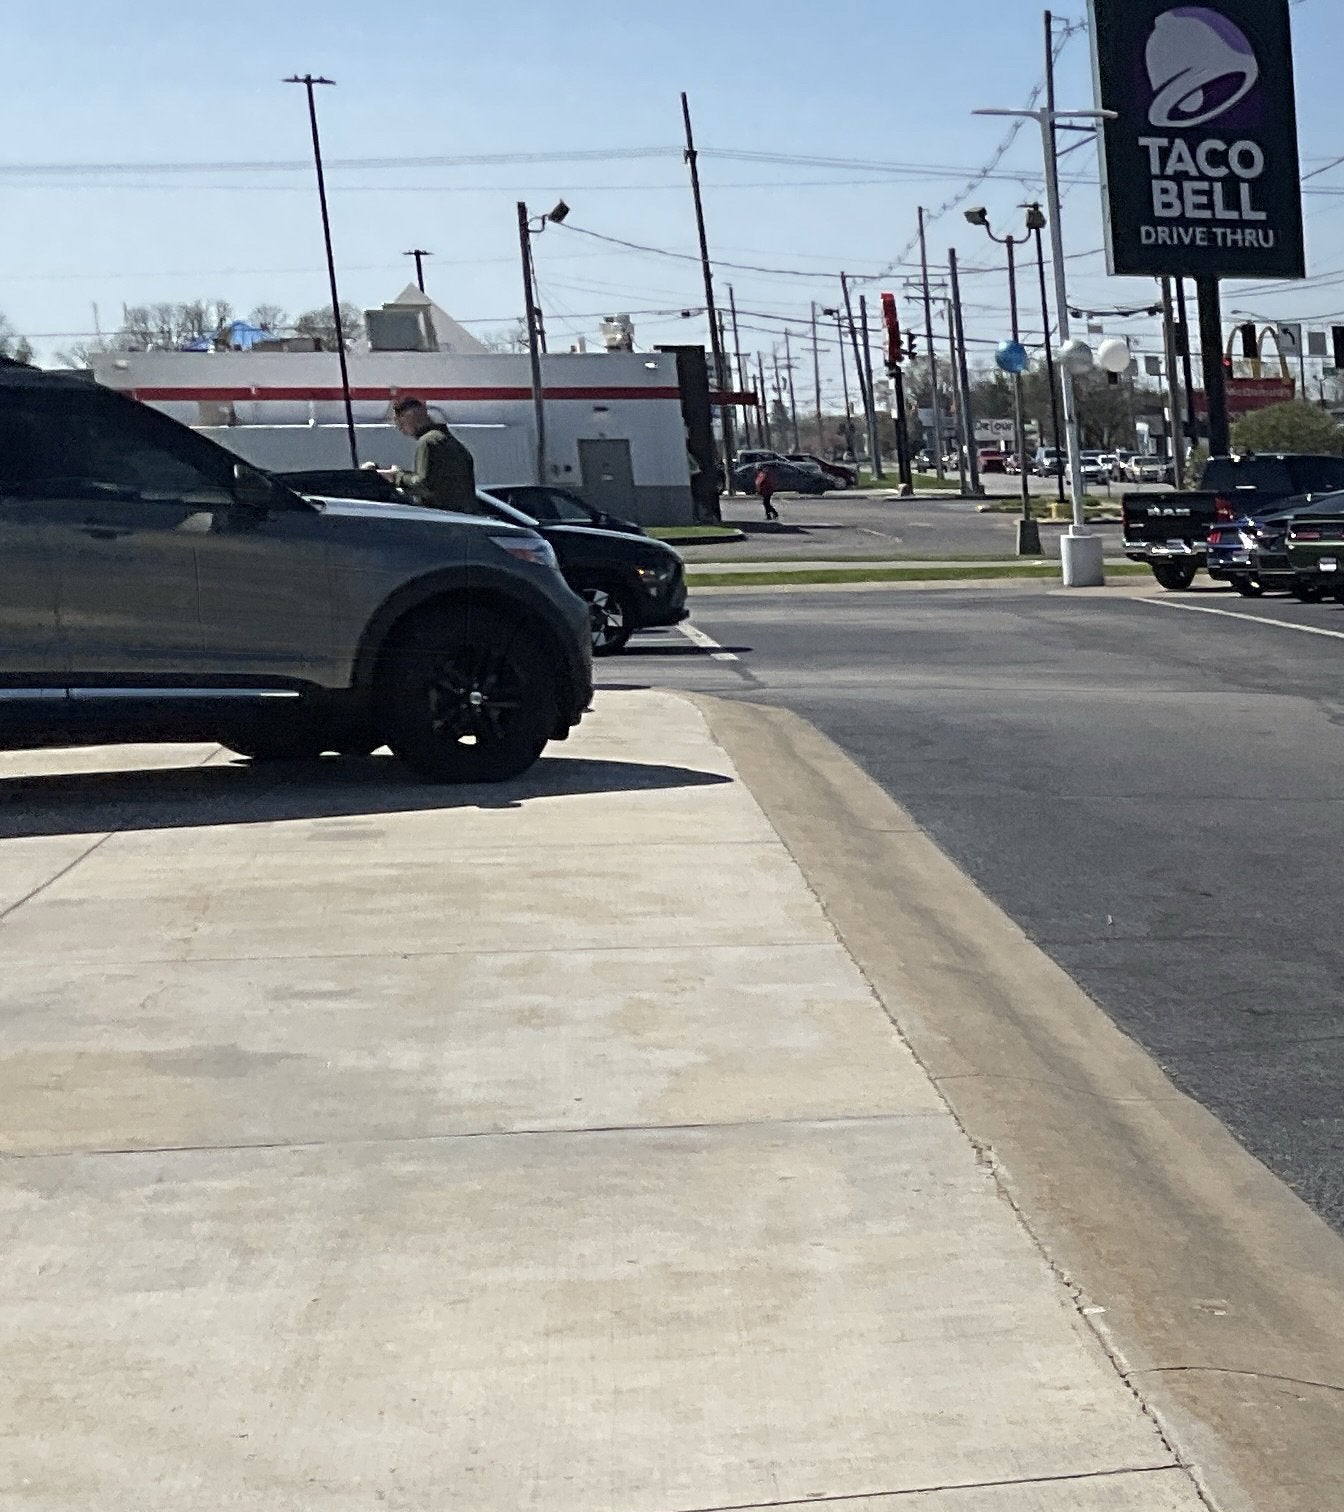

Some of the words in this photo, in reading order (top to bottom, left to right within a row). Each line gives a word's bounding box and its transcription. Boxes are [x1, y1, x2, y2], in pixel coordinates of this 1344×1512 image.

[1138, 136, 1264, 179] TACO
[1151, 179, 1267, 220] BELL
[1140, 226, 1209, 245] DRIVE
[1212, 227, 1275, 248] THRU
